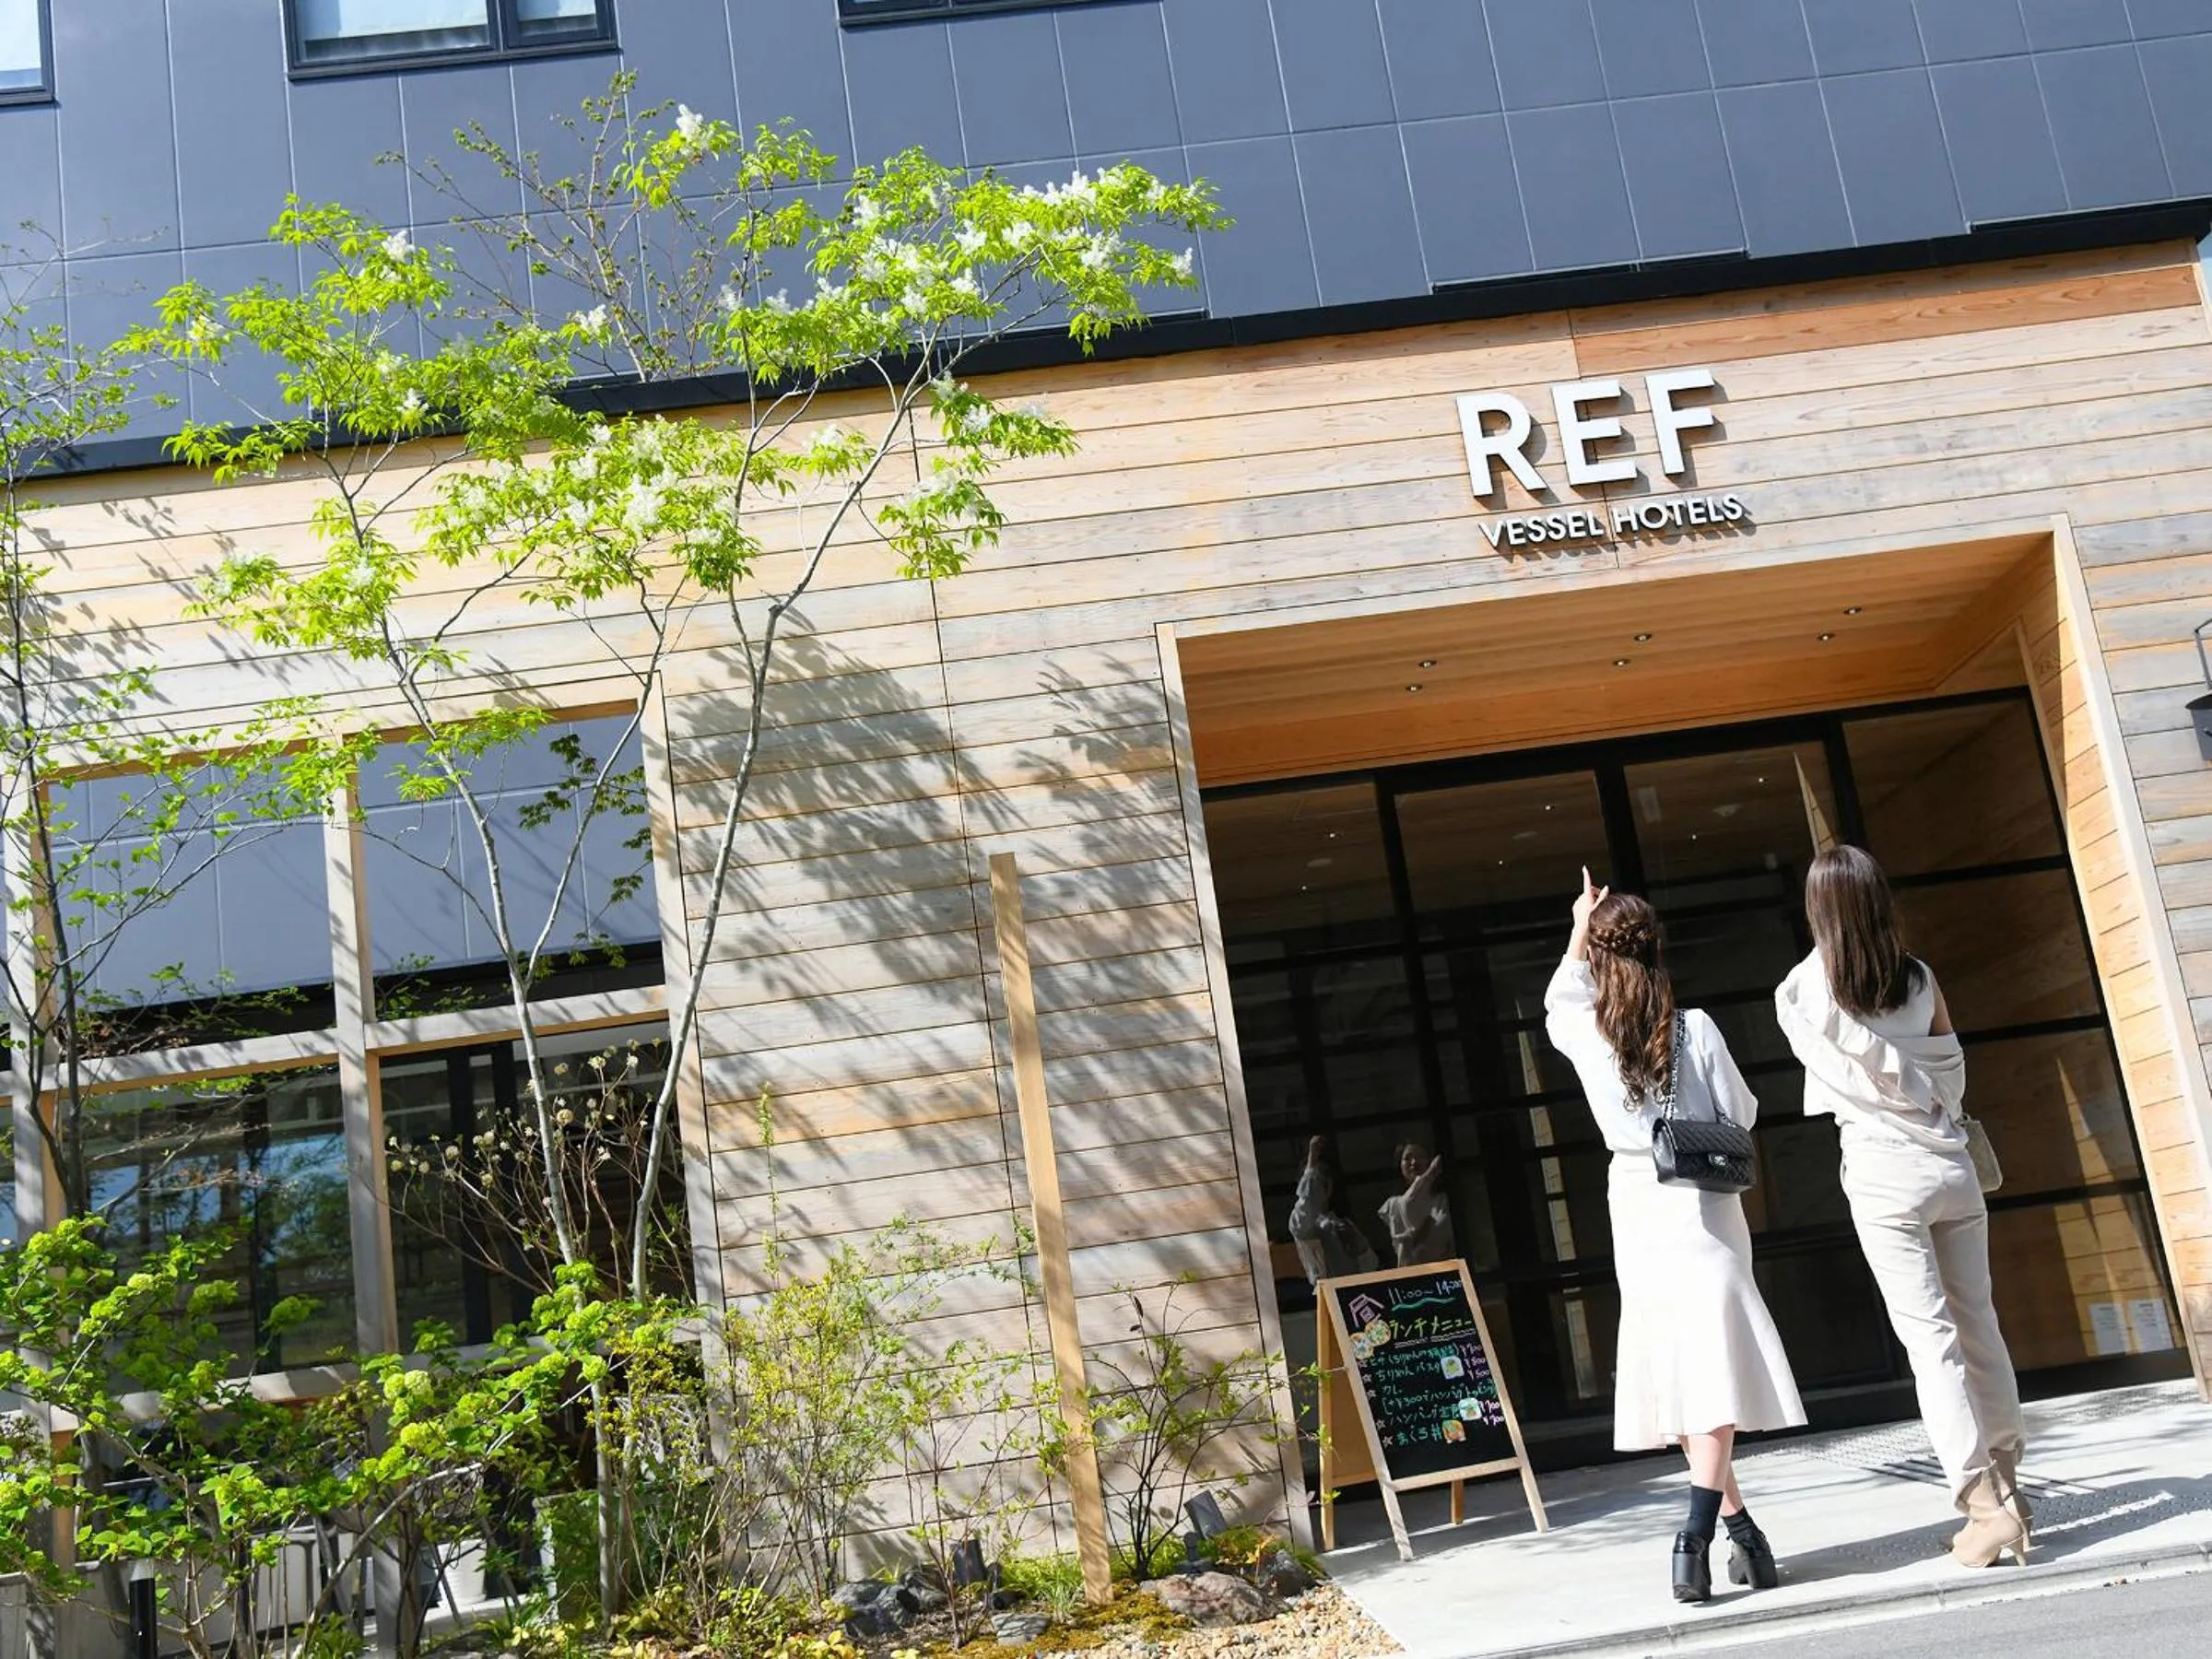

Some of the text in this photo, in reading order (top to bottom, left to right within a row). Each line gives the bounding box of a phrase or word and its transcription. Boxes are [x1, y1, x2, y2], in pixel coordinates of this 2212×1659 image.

[1456, 369, 1715, 497] REF
[1478, 493, 1743, 547] VESSEL HOTELS
[1389, 1315, 1473, 1339] ランチメニュー
